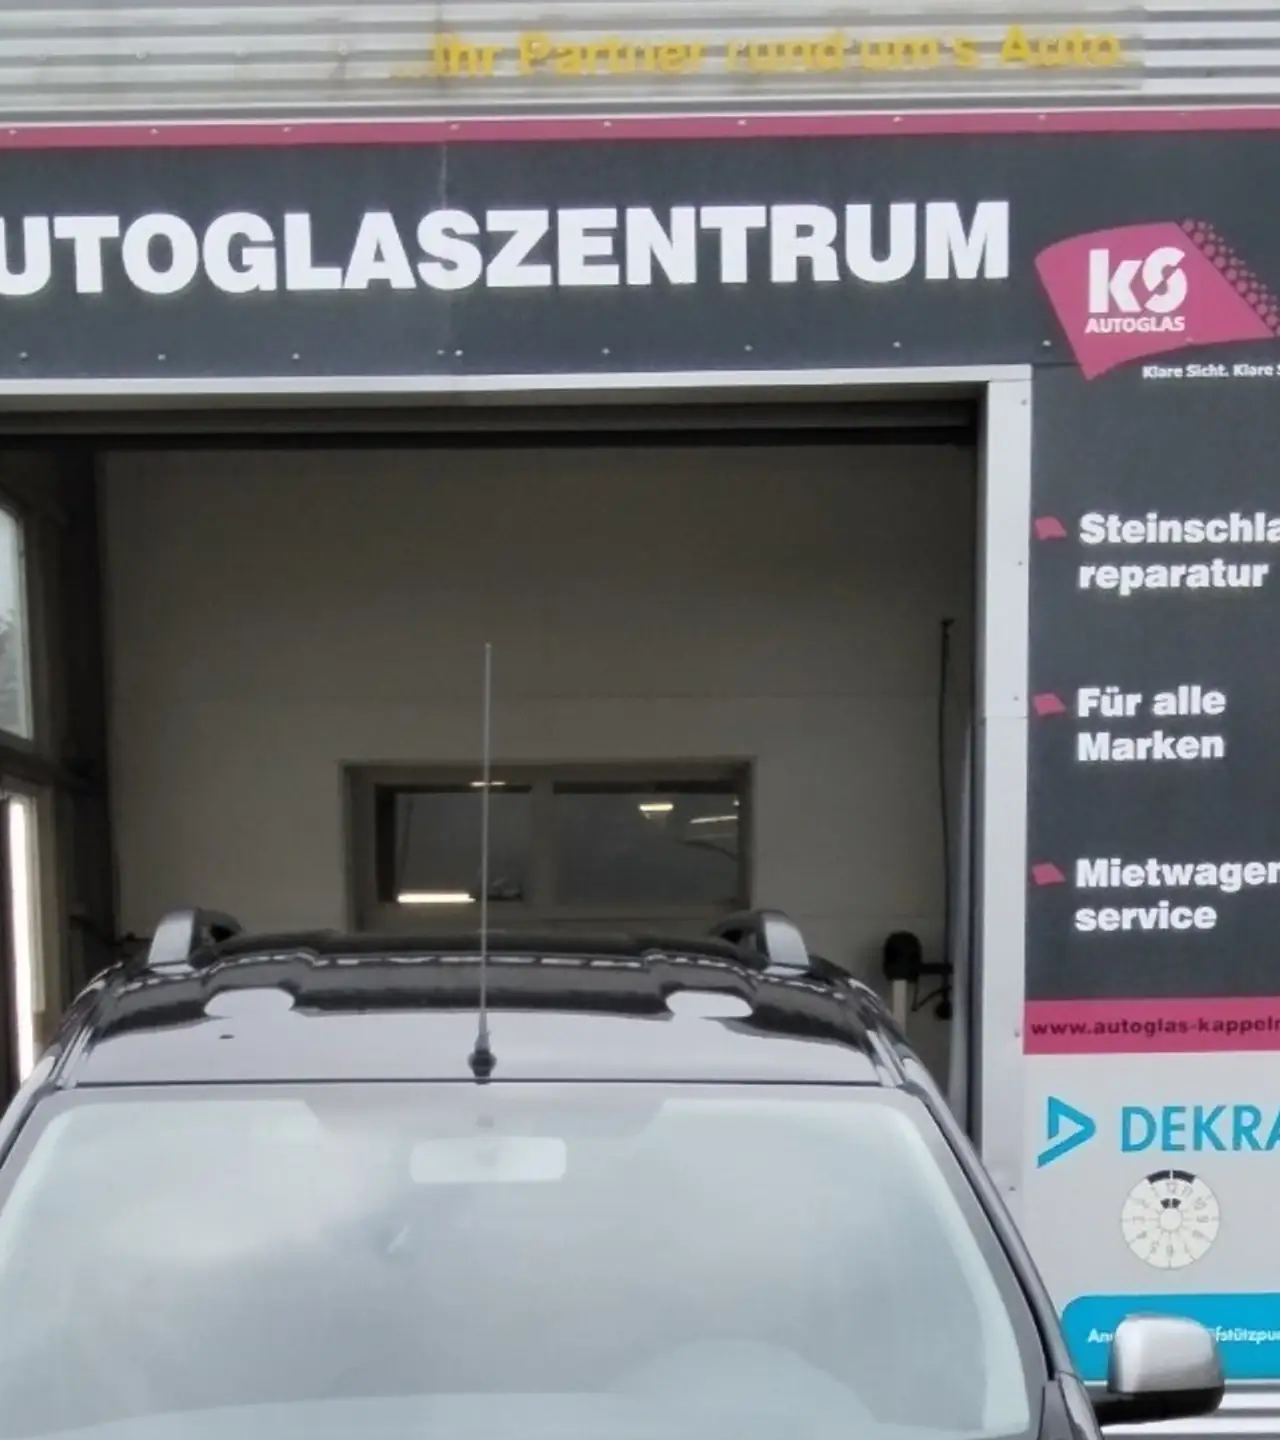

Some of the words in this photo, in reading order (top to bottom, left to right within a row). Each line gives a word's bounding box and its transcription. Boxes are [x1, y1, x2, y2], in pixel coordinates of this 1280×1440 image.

[519, 31, 706, 77] Partner
[726, 28, 844, 73] rund
[1001, 22, 1119, 68] Auto
[1085, 316, 1185, 334] AUTOGLAS
[1142, 365, 1184, 379] Klare
[1233, 363, 1273, 377] Klare
[1079, 559, 1269, 596] reparatur
[1078, 687, 1143, 717] Für
[1151, 686, 1226, 716] alle
[1078, 731, 1225, 761] Marken
[1075, 900, 1217, 931] service
